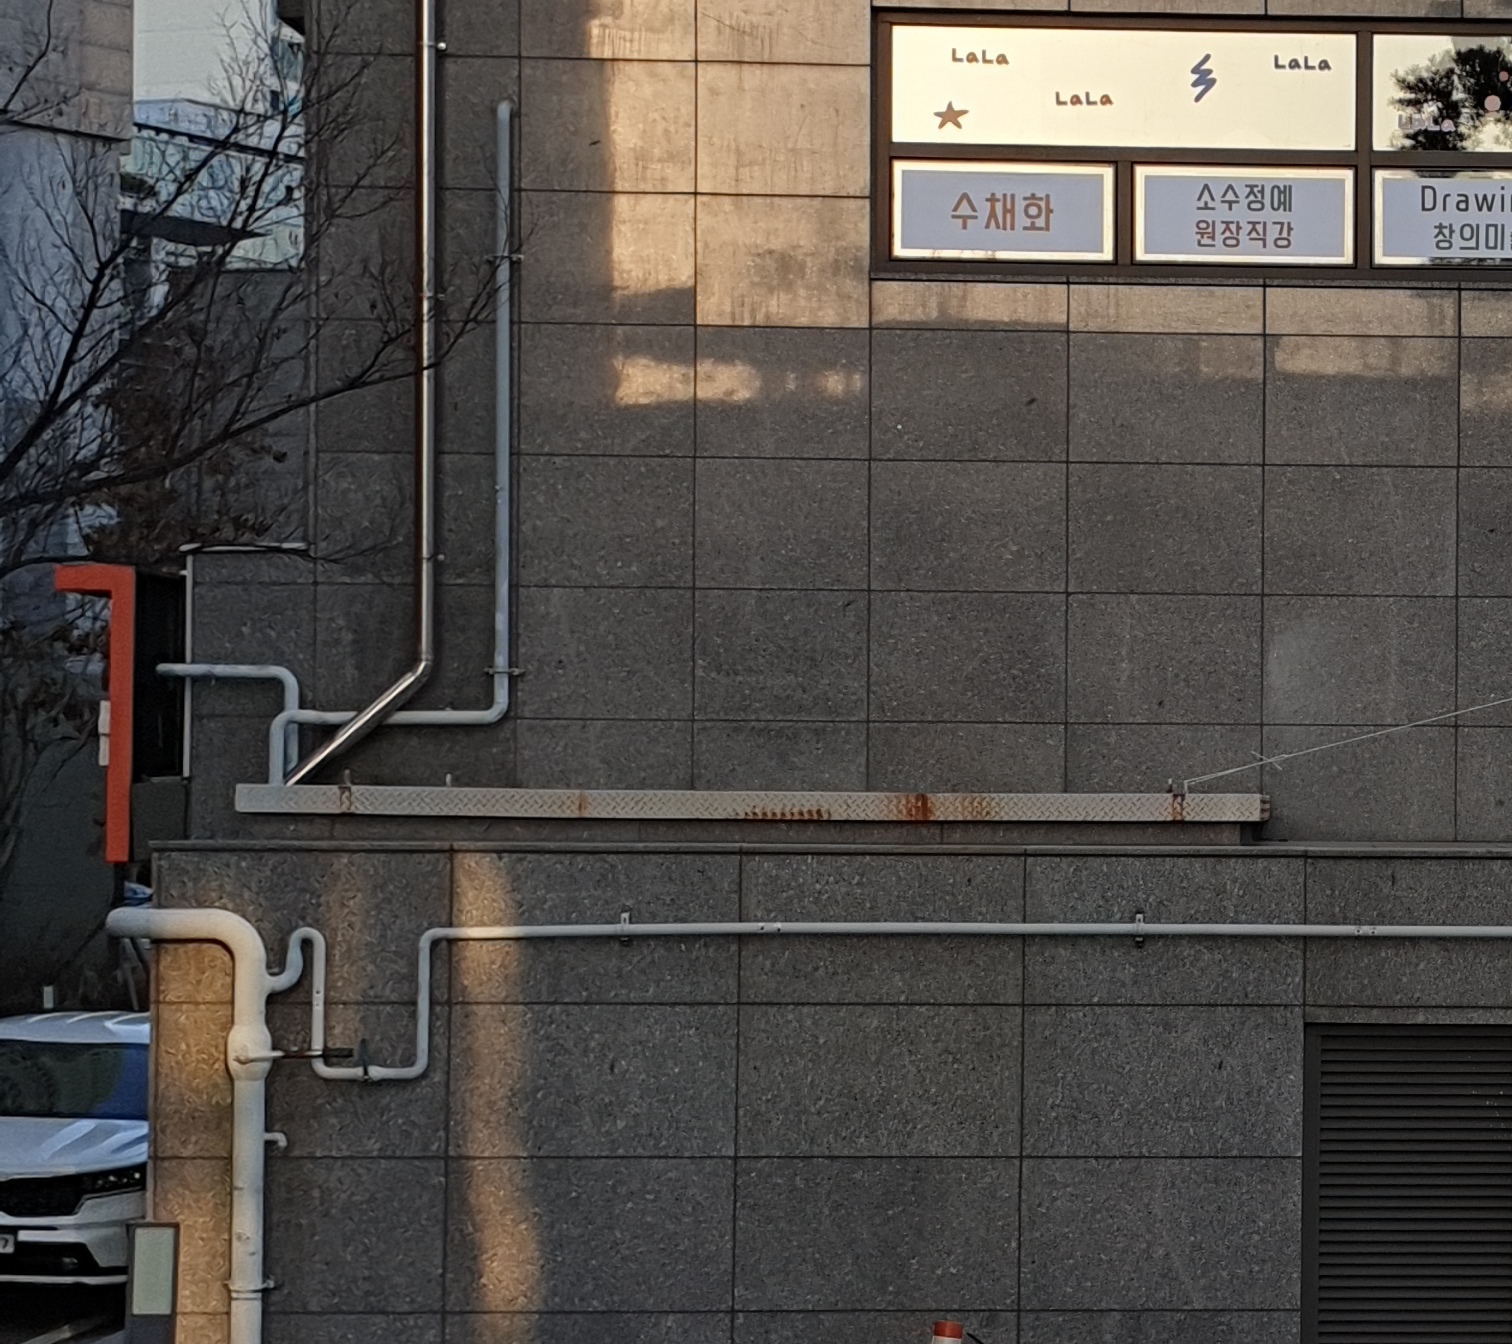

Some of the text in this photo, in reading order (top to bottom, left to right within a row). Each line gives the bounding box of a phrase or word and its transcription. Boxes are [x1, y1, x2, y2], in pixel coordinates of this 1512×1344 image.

[951, 48, 1010, 66] LaLa
[1273, 54, 1332, 72] LaLa
[1055, 90, 1113, 107] LaLa
[1196, 183, 1293, 213] 소수정예
[951, 192, 1054, 233] 수채화
[1195, 219, 1294, 249] 원장직강
